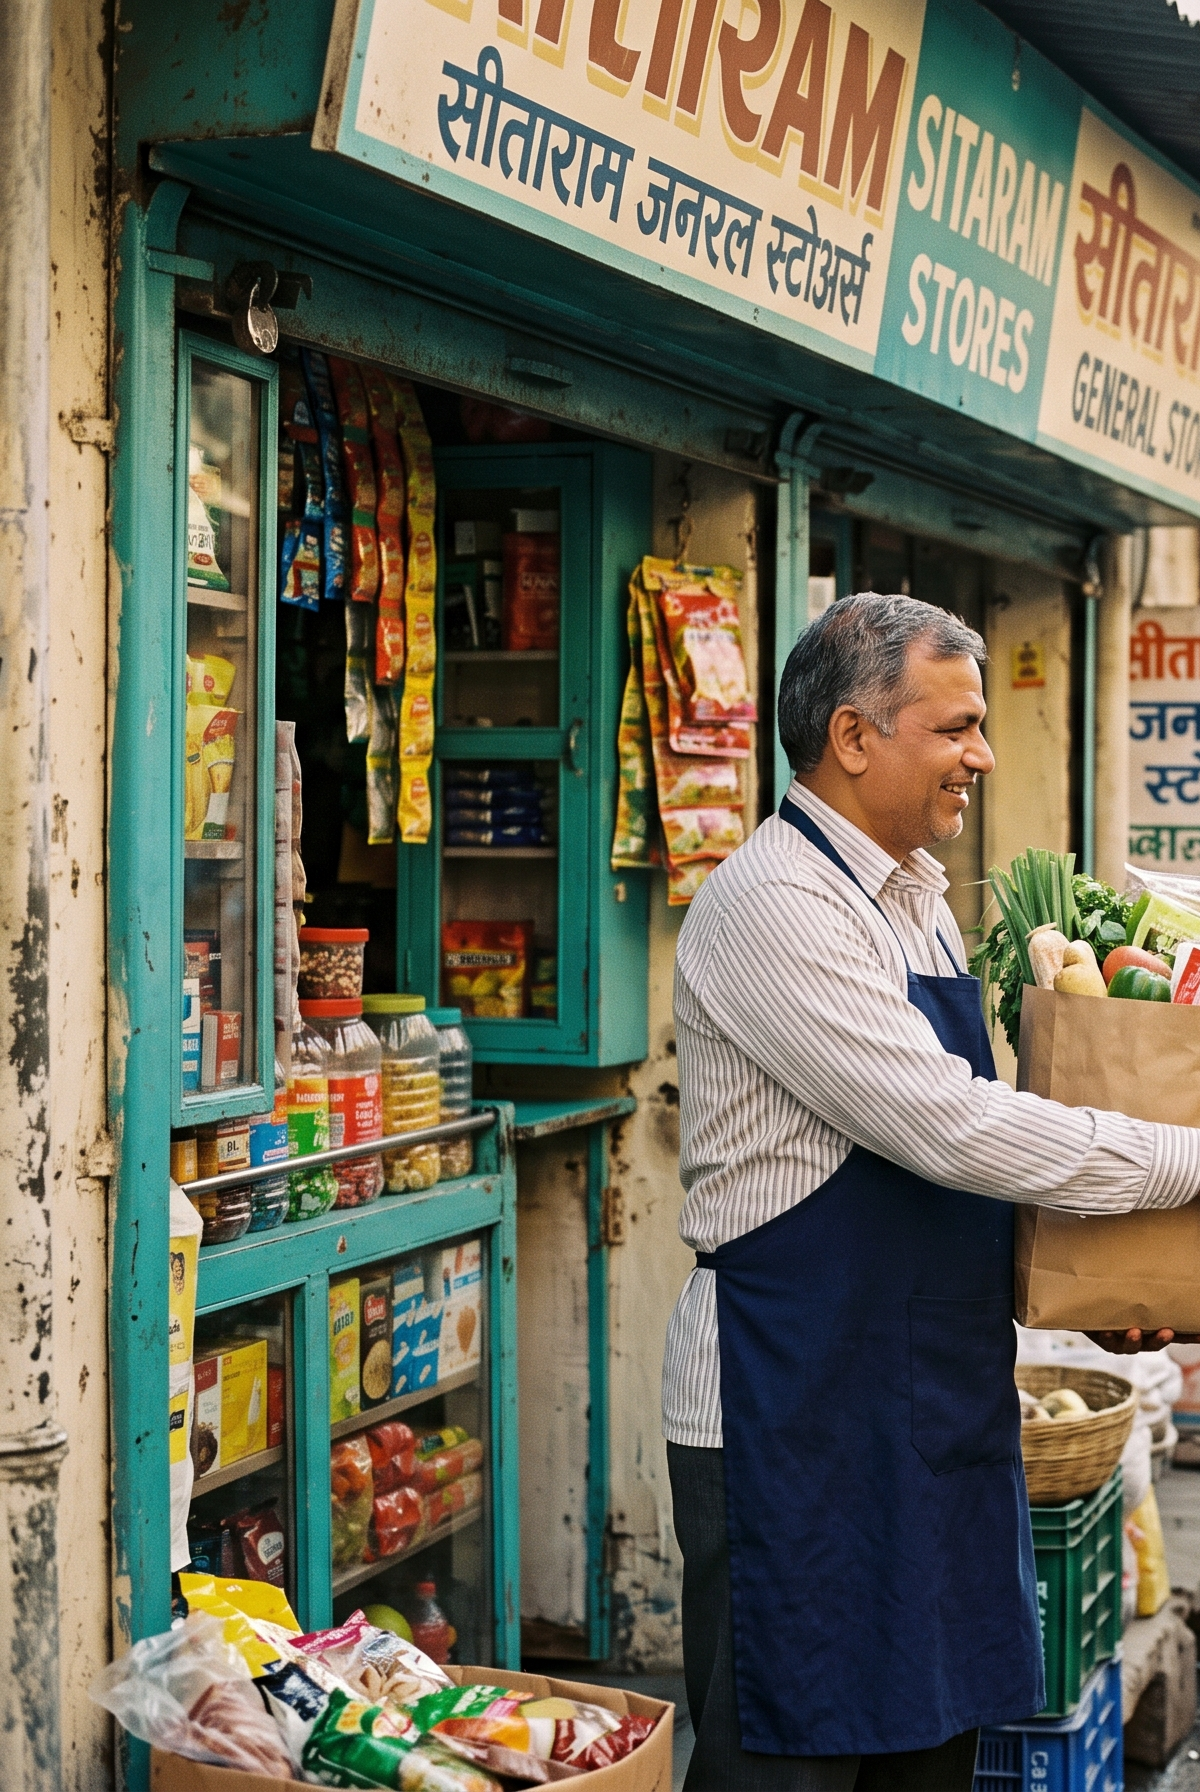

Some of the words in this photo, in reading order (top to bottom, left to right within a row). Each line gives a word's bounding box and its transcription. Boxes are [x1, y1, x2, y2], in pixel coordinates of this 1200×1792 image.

[437, 45, 636, 223] सीताराम
[636, 156, 763, 278] जनरल
[906, 94, 1065, 288] SITARAM
[901, 253, 1034, 394] STORES
[1072, 351, 1160, 457] GENERAL
